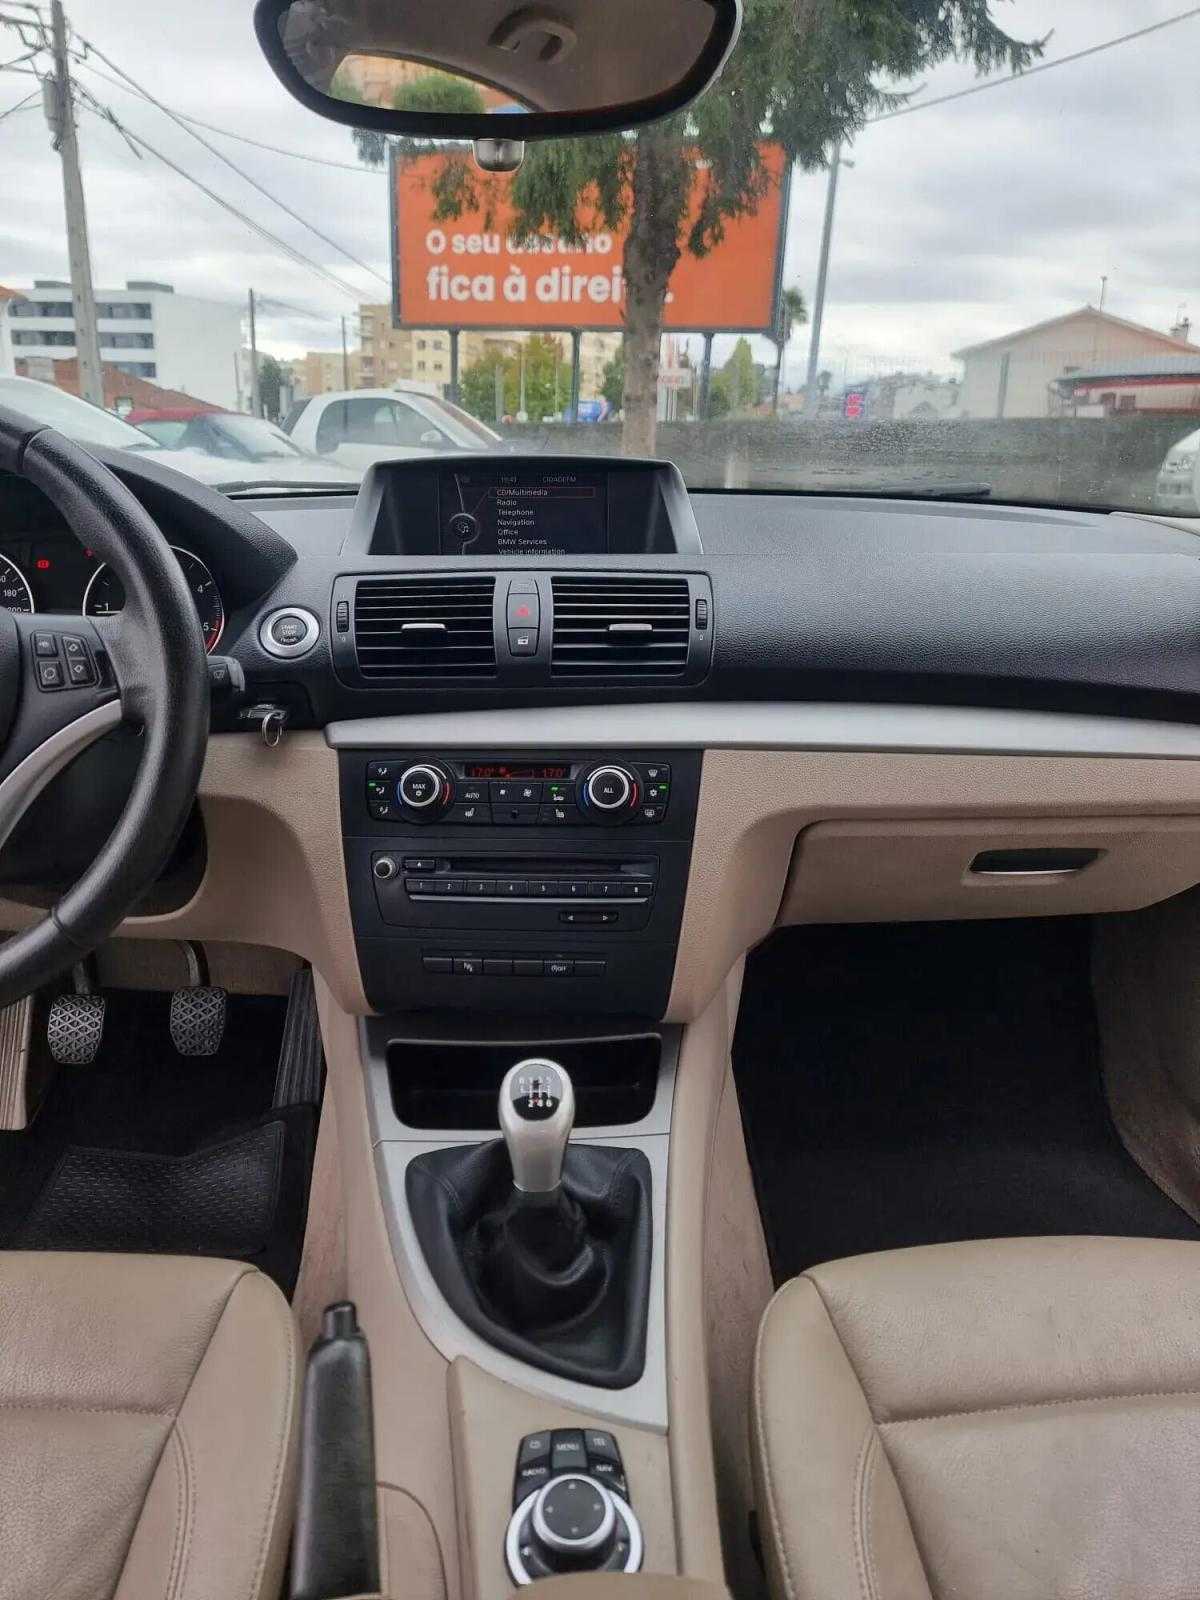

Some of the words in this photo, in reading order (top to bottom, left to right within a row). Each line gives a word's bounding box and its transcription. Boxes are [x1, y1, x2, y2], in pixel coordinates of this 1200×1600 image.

[425, 229, 446, 254] O
[451, 233, 500, 254] seu
[426, 264, 496, 301] fica
[502, 264, 527, 302] à
[497, 509, 534, 517] Telephone
[497, 519, 535, 527] Navigation
[3, 589, 17, 597] 180
[522, 1467, 546, 1476] RADIO
